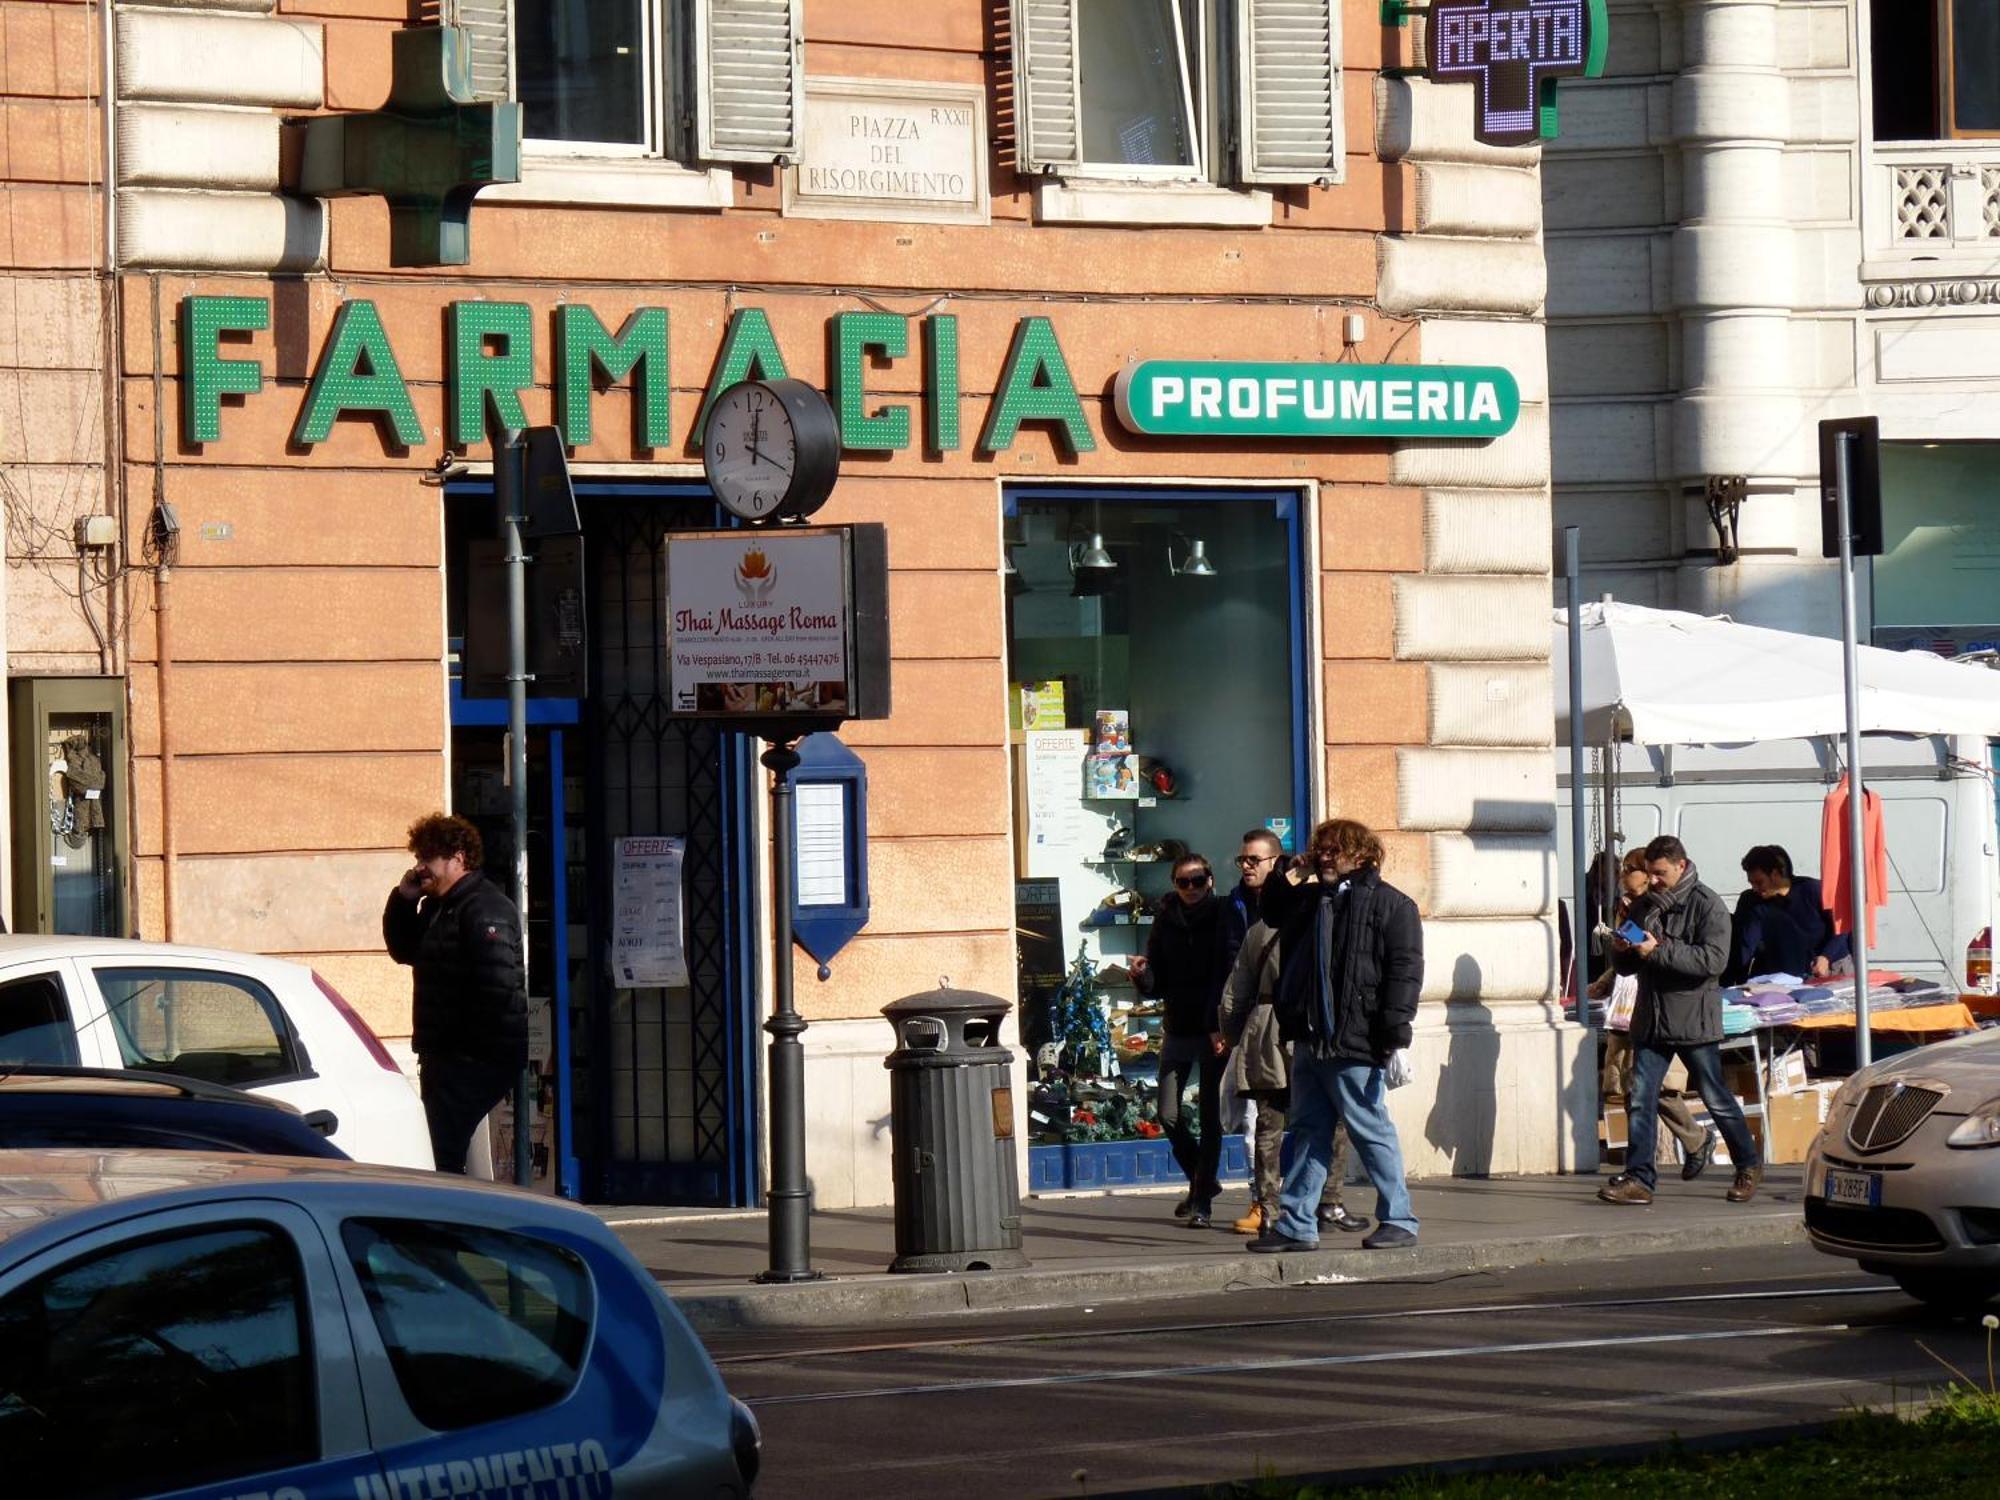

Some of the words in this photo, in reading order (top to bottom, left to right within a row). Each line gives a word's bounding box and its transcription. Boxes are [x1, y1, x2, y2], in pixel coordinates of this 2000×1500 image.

[1443, 8, 1576, 63] APERTA
[849, 115, 920, 140] PIAZZA
[943, 108, 971, 127] XXII
[870, 145, 903, 164] DEL
[809, 168, 964, 195] RISORGIMENTO
[183, 295, 1098, 455] FARMACIA
[747, 391, 763, 413] 12
[1150, 375, 1503, 422] PROFUMERIA
[715, 442, 726, 464] 9
[753, 490, 763, 511] 6
[676, 608, 713, 632] Thai
[714, 608, 785, 635] Massage
[788, 606, 837, 630] Roma
[677, 655, 690, 666] Via
[784, 654, 795, 664] 06
[706, 668, 810, 681] www.thaimassageroma.it
[1034, 738, 1075, 750] OFFERTE
[623, 839, 674, 854] OFFERTE
